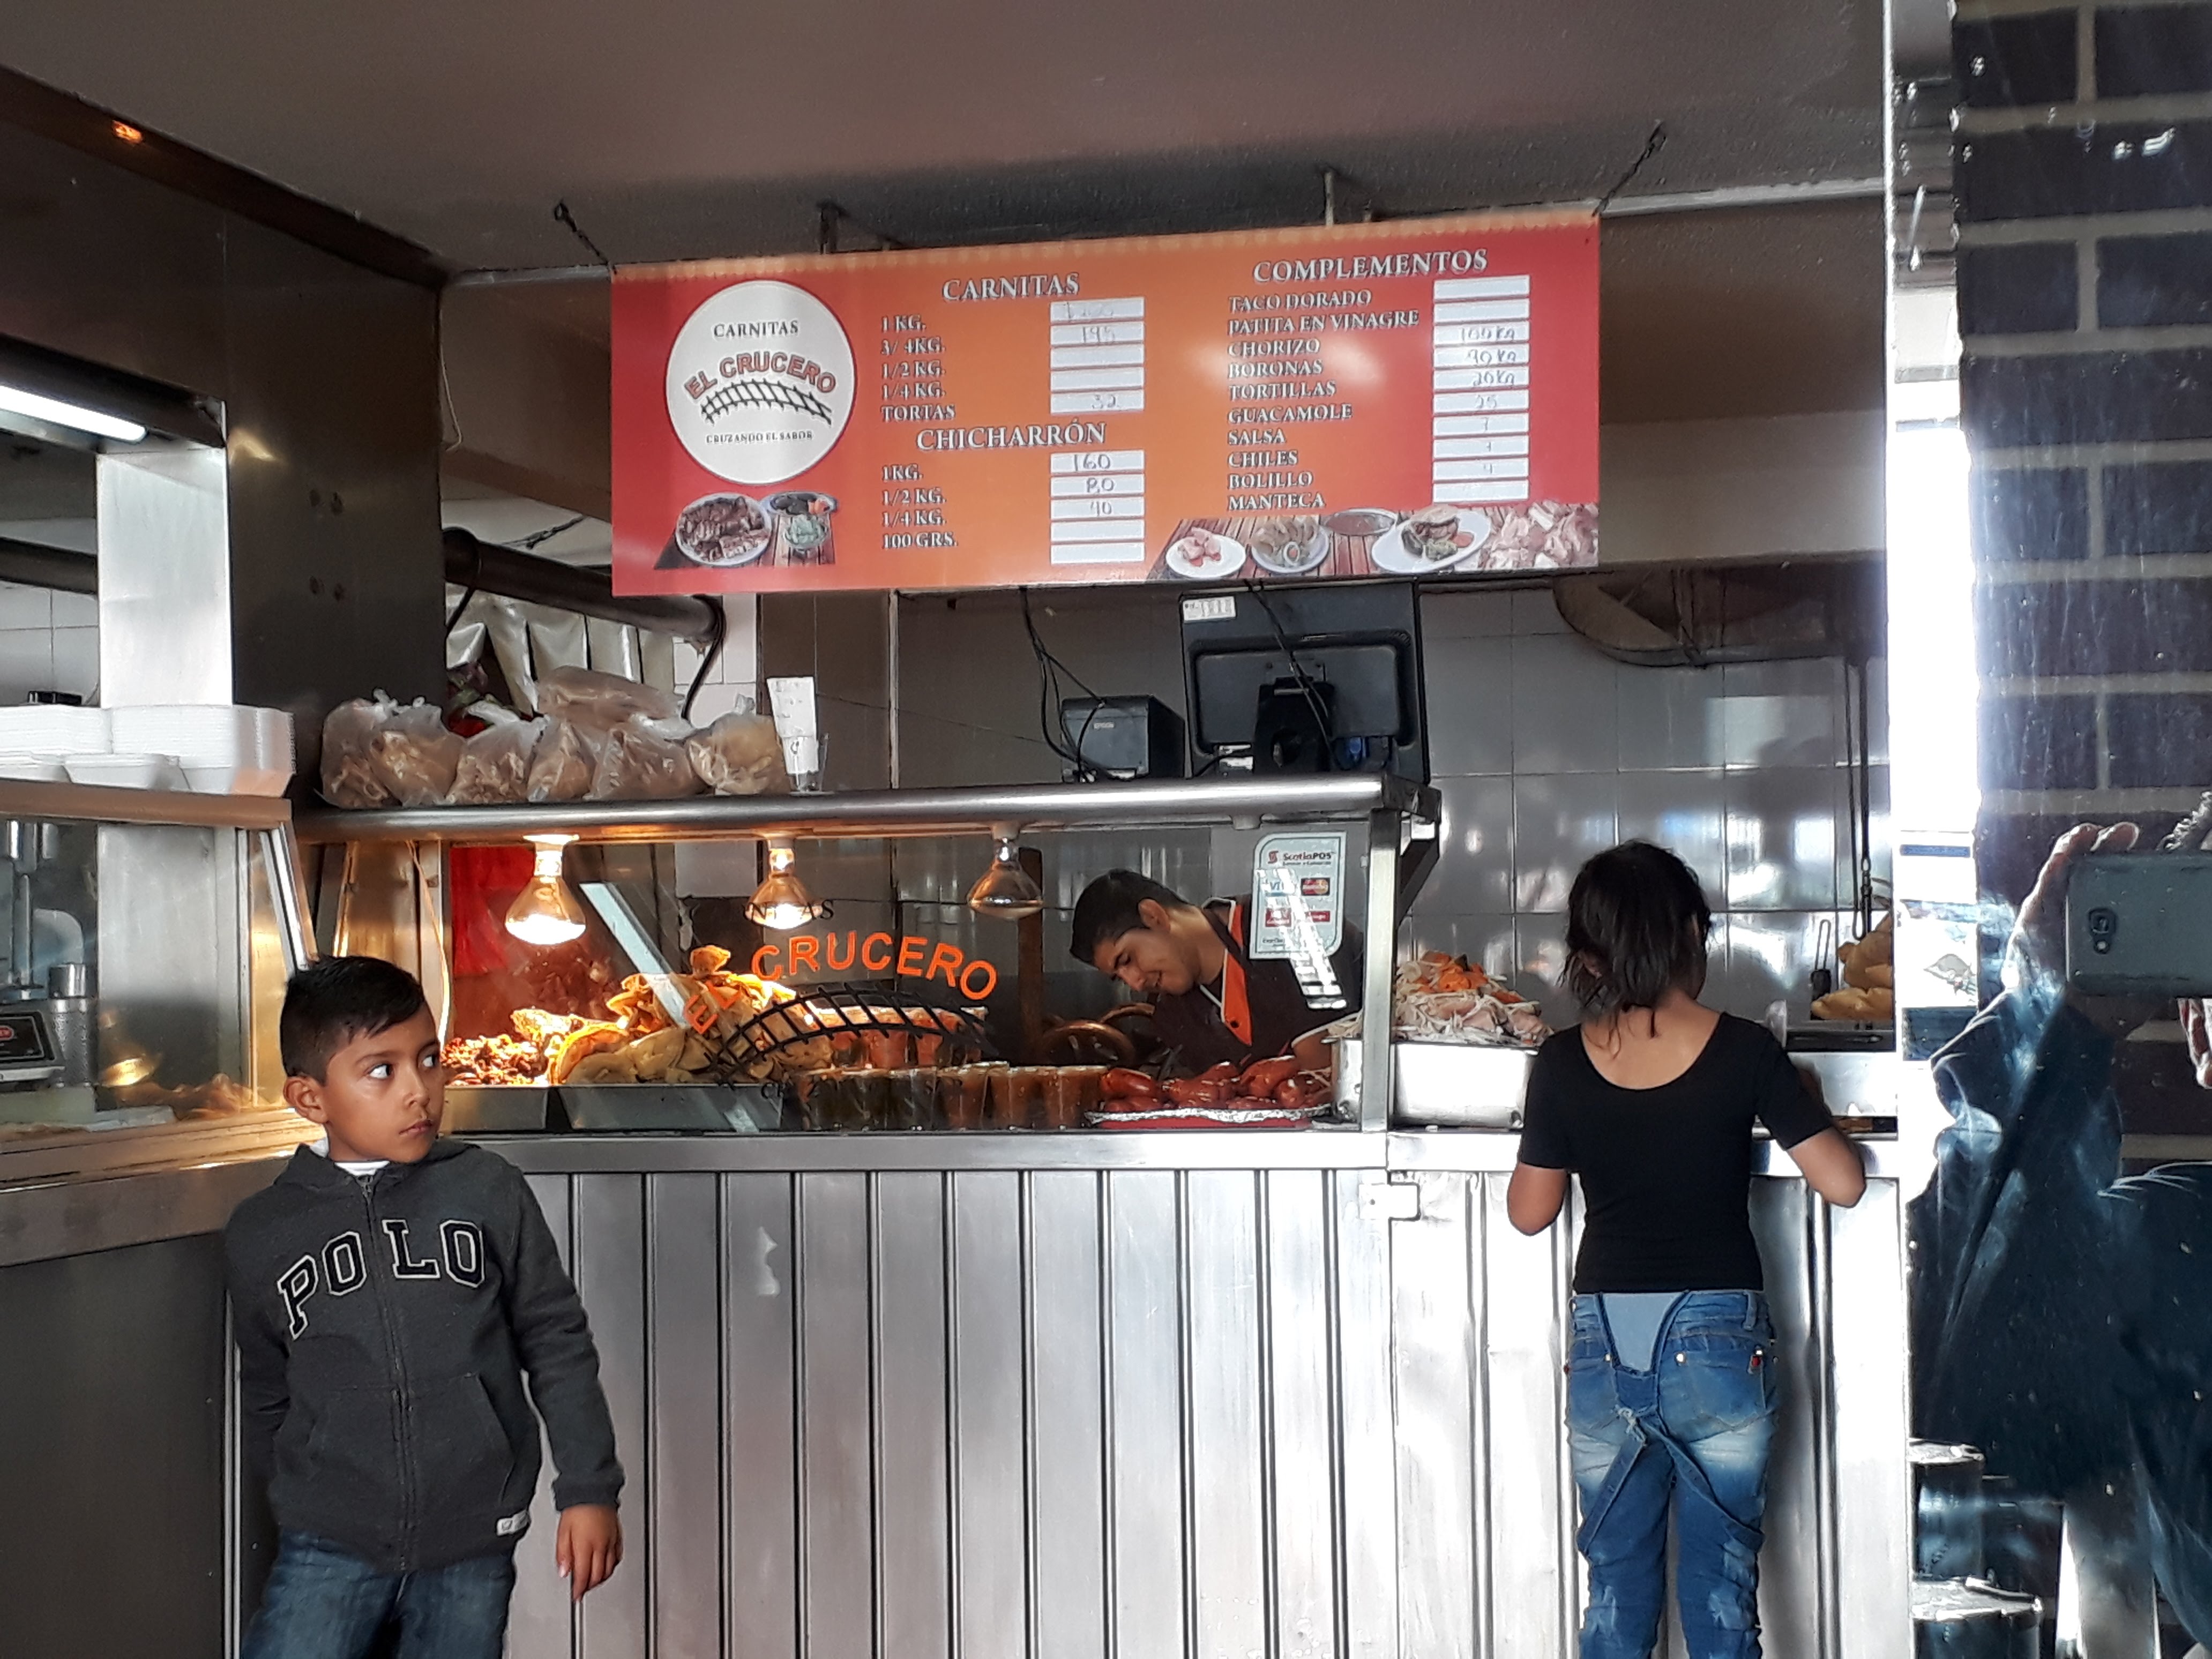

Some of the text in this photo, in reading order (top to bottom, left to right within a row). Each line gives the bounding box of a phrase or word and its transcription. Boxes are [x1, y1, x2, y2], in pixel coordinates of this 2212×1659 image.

[1253, 248, 1488, 284] COMPLEMENTOS
[943, 273, 1080, 300] CARNITAS
[1229, 289, 1372, 312] TACO DORADO
[714, 320, 798, 338] CARNITAS
[1229, 310, 1419, 335] PATITA EN VINAGRE
[1228, 338, 1320, 357] CHORIZO
[684, 351, 836, 399] EL CRUCERO
[1228, 360, 1322, 378] BORONAS
[1229, 380, 1336, 400] TORTILLAS
[881, 404, 955, 421] TORTAS
[1228, 403, 1352, 423] GUACAMOLE
[706, 431, 813, 444] CRUZANDO EL SABOR
[916, 418, 1107, 451] CHICHARRÓN
[1228, 429, 1286, 445] SALSA
[1228, 450, 1298, 467] CHILES
[1228, 472, 1313, 489] BOLILLO
[1228, 493, 1325, 511] MANTECA
[882, 533, 911, 550] 100
[752, 931, 997, 1000] CRUCERO
[277, 1219, 485, 1340] POLO
